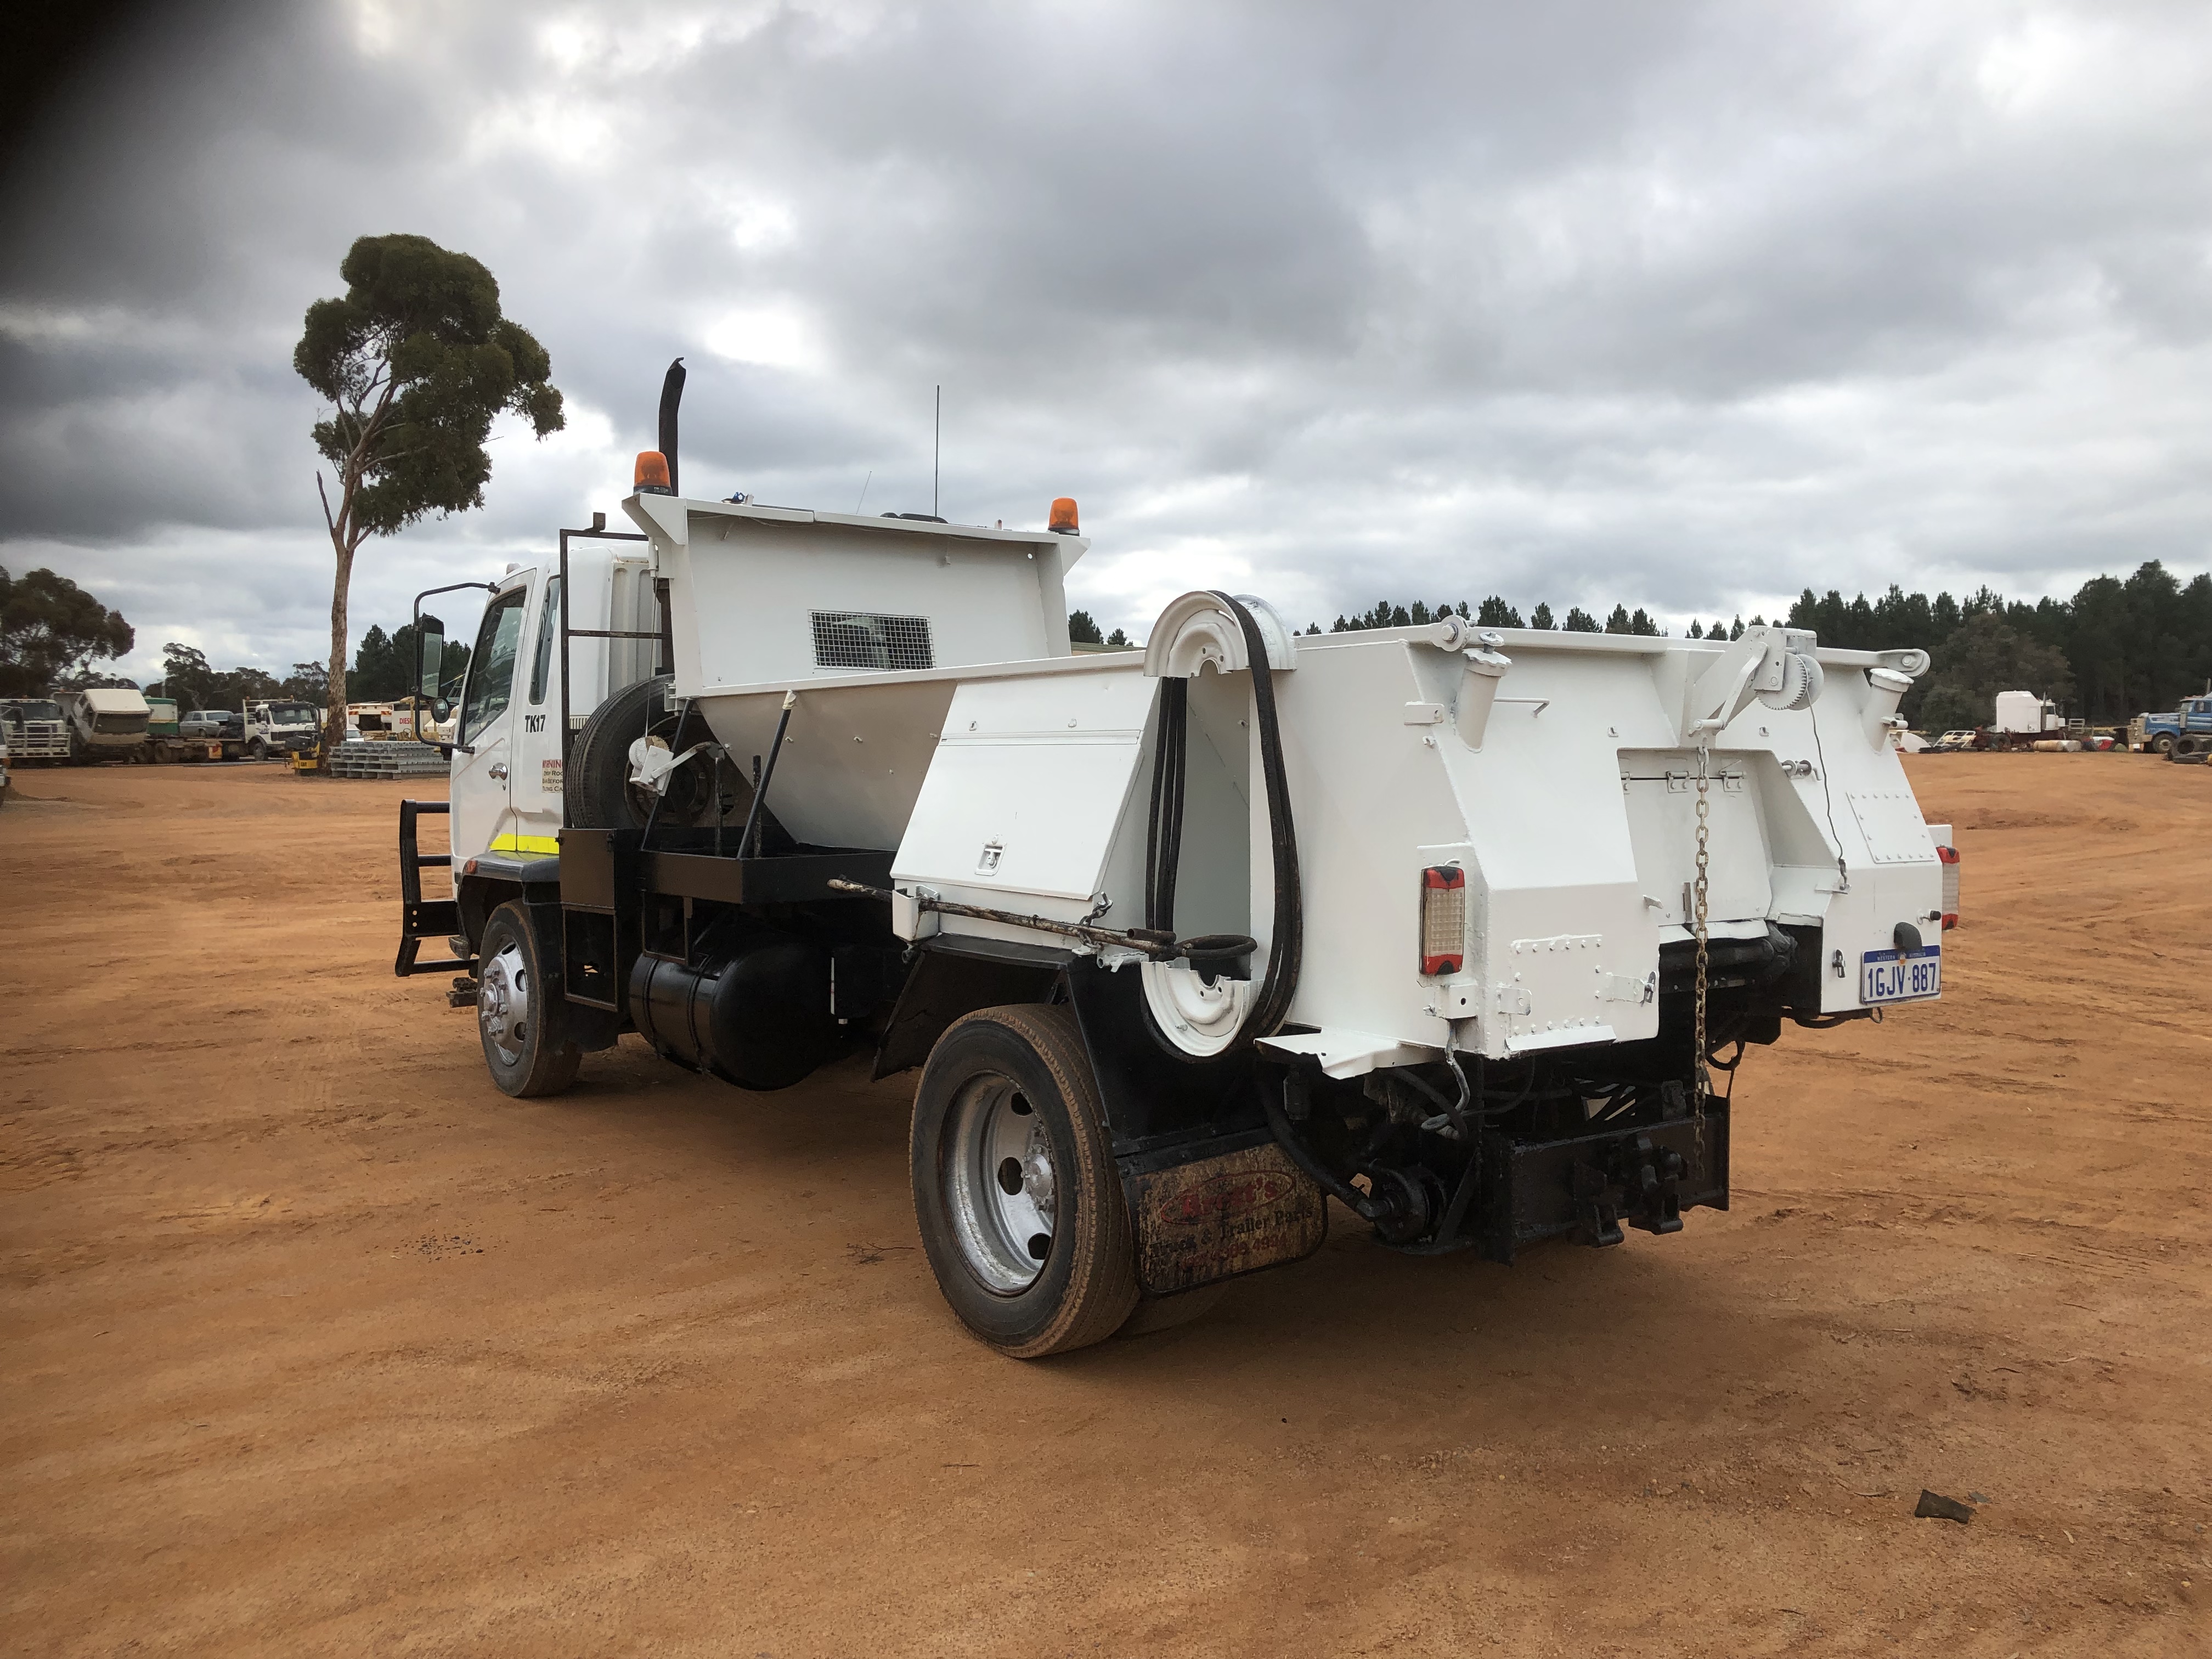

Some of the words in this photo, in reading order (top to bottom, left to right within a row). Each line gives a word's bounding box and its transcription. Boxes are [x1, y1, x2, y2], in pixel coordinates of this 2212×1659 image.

[525, 714, 546, 733] TK17
[543, 760, 563, 768] WARNIN
[1220, 1216, 1271, 1239] Trailer
[1275, 1206, 1313, 1226] Parts
